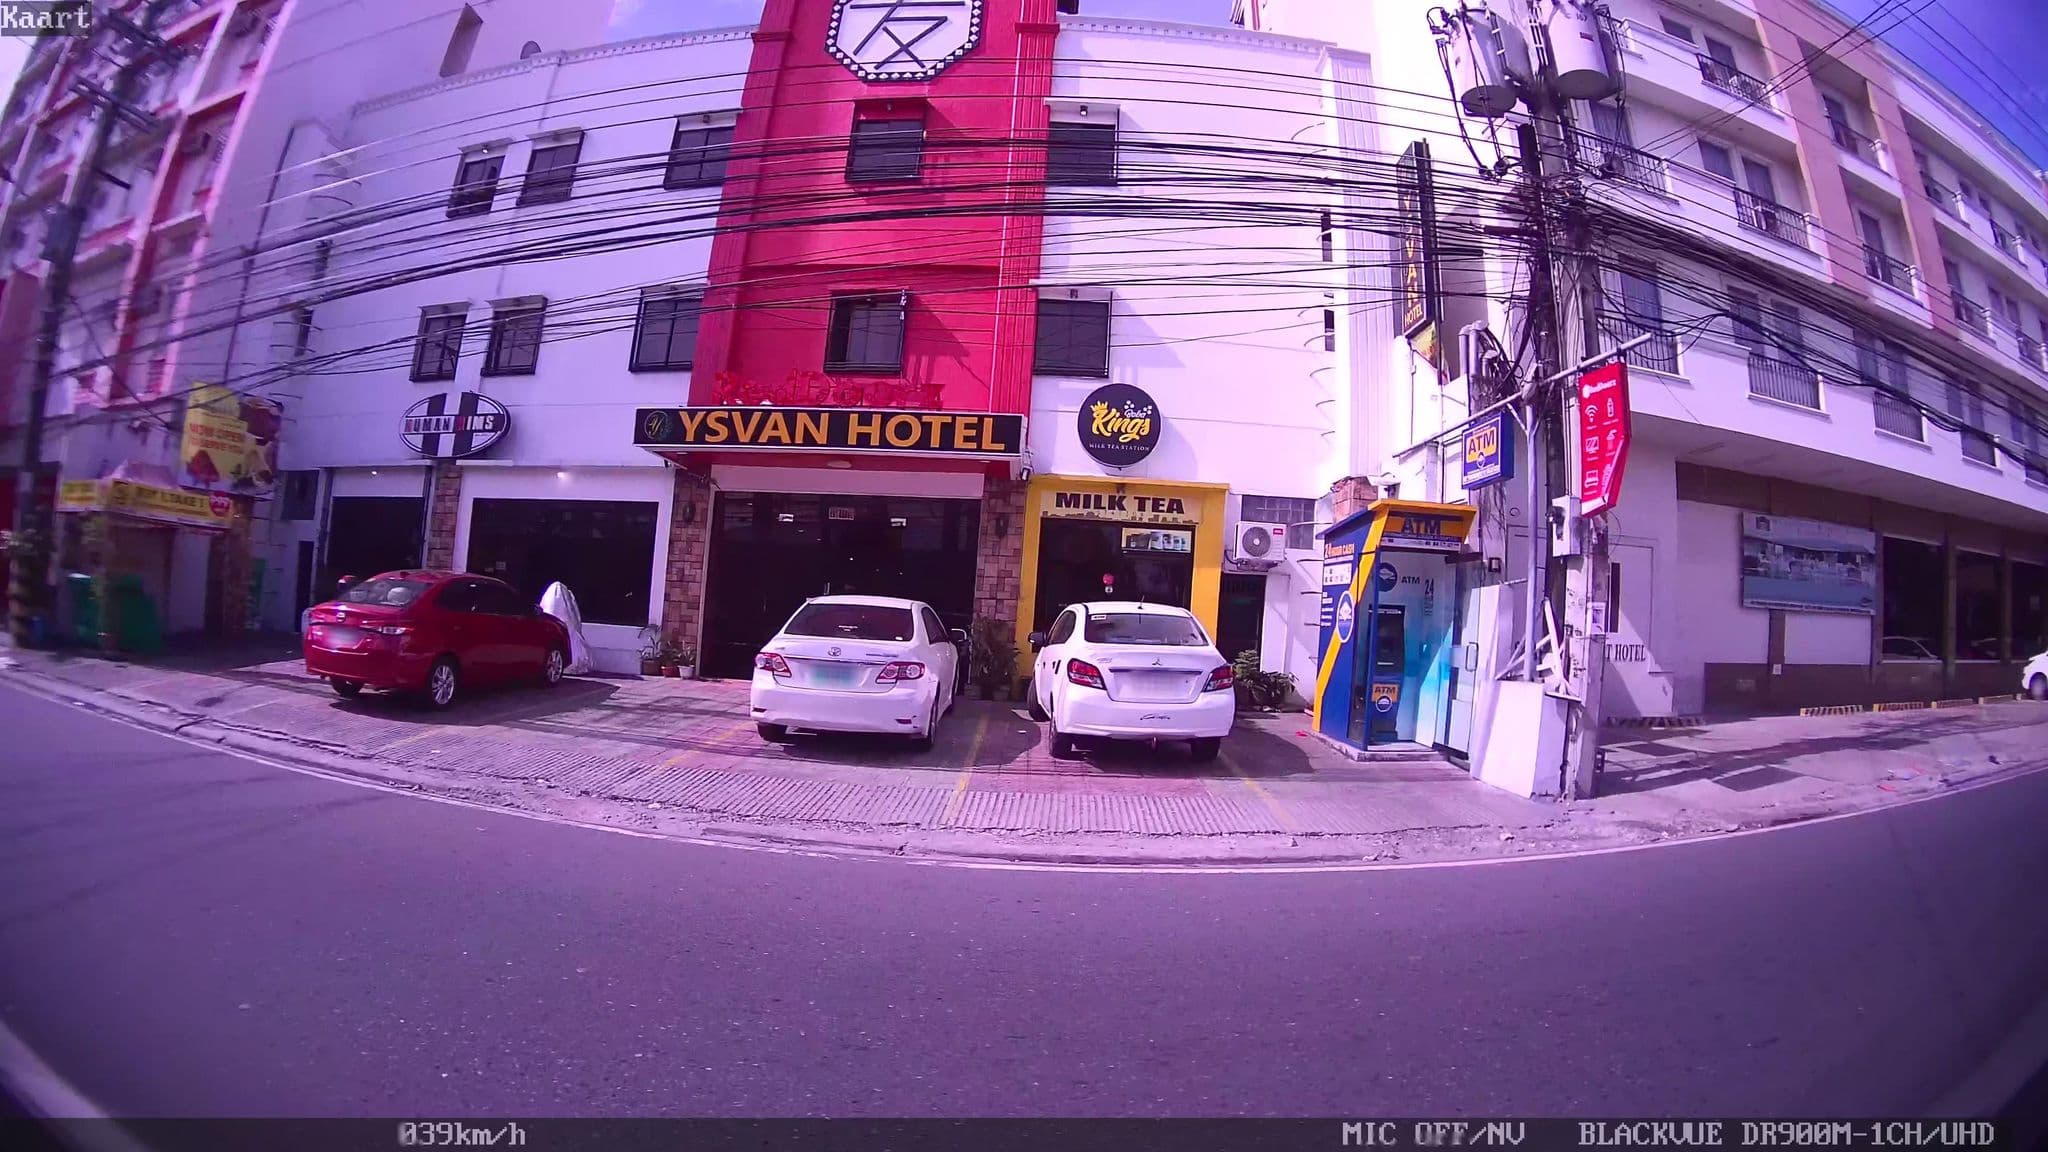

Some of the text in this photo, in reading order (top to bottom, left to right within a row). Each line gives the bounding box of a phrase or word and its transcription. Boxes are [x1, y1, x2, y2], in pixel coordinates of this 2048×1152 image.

[1404, 303, 1423, 328] HOTEL
[679, 411, 1005, 450] YSVAN HOTEL
[1091, 407, 1151, 443] Kings
[1468, 429, 1494, 456] ATM
[1055, 492, 1184, 514] MILK TEA
[1401, 516, 1441, 536] ATM
[1401, 576, 1421, 584] ATM
[1425, 579, 1434, 595] 24
[1615, 644, 1646, 661] HOTEL
[1374, 686, 1396, 695] ATM
